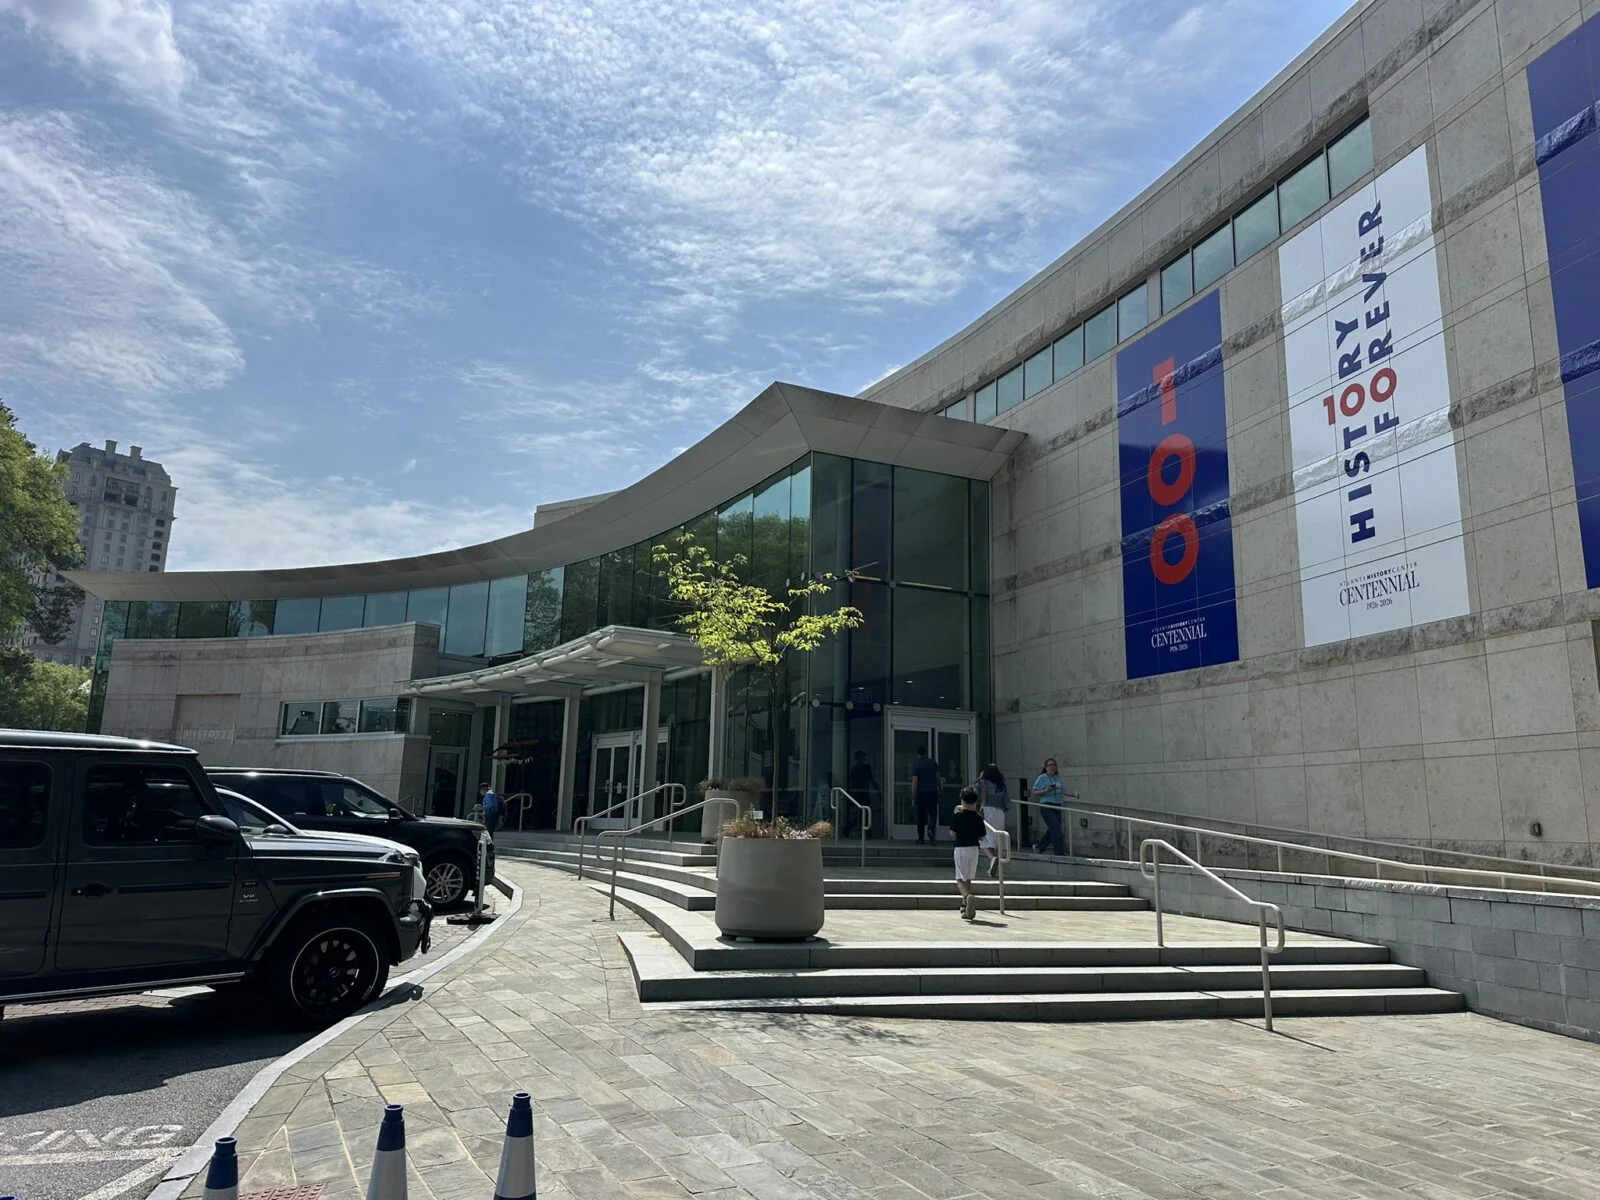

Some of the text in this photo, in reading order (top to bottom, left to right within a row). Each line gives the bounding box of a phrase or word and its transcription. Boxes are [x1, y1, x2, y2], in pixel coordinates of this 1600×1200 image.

[1147, 356, 1199, 585] 100
[1340, 570, 1420, 606] CENTENNIAL
[1151, 623, 1207, 648] CENTENNIAL
